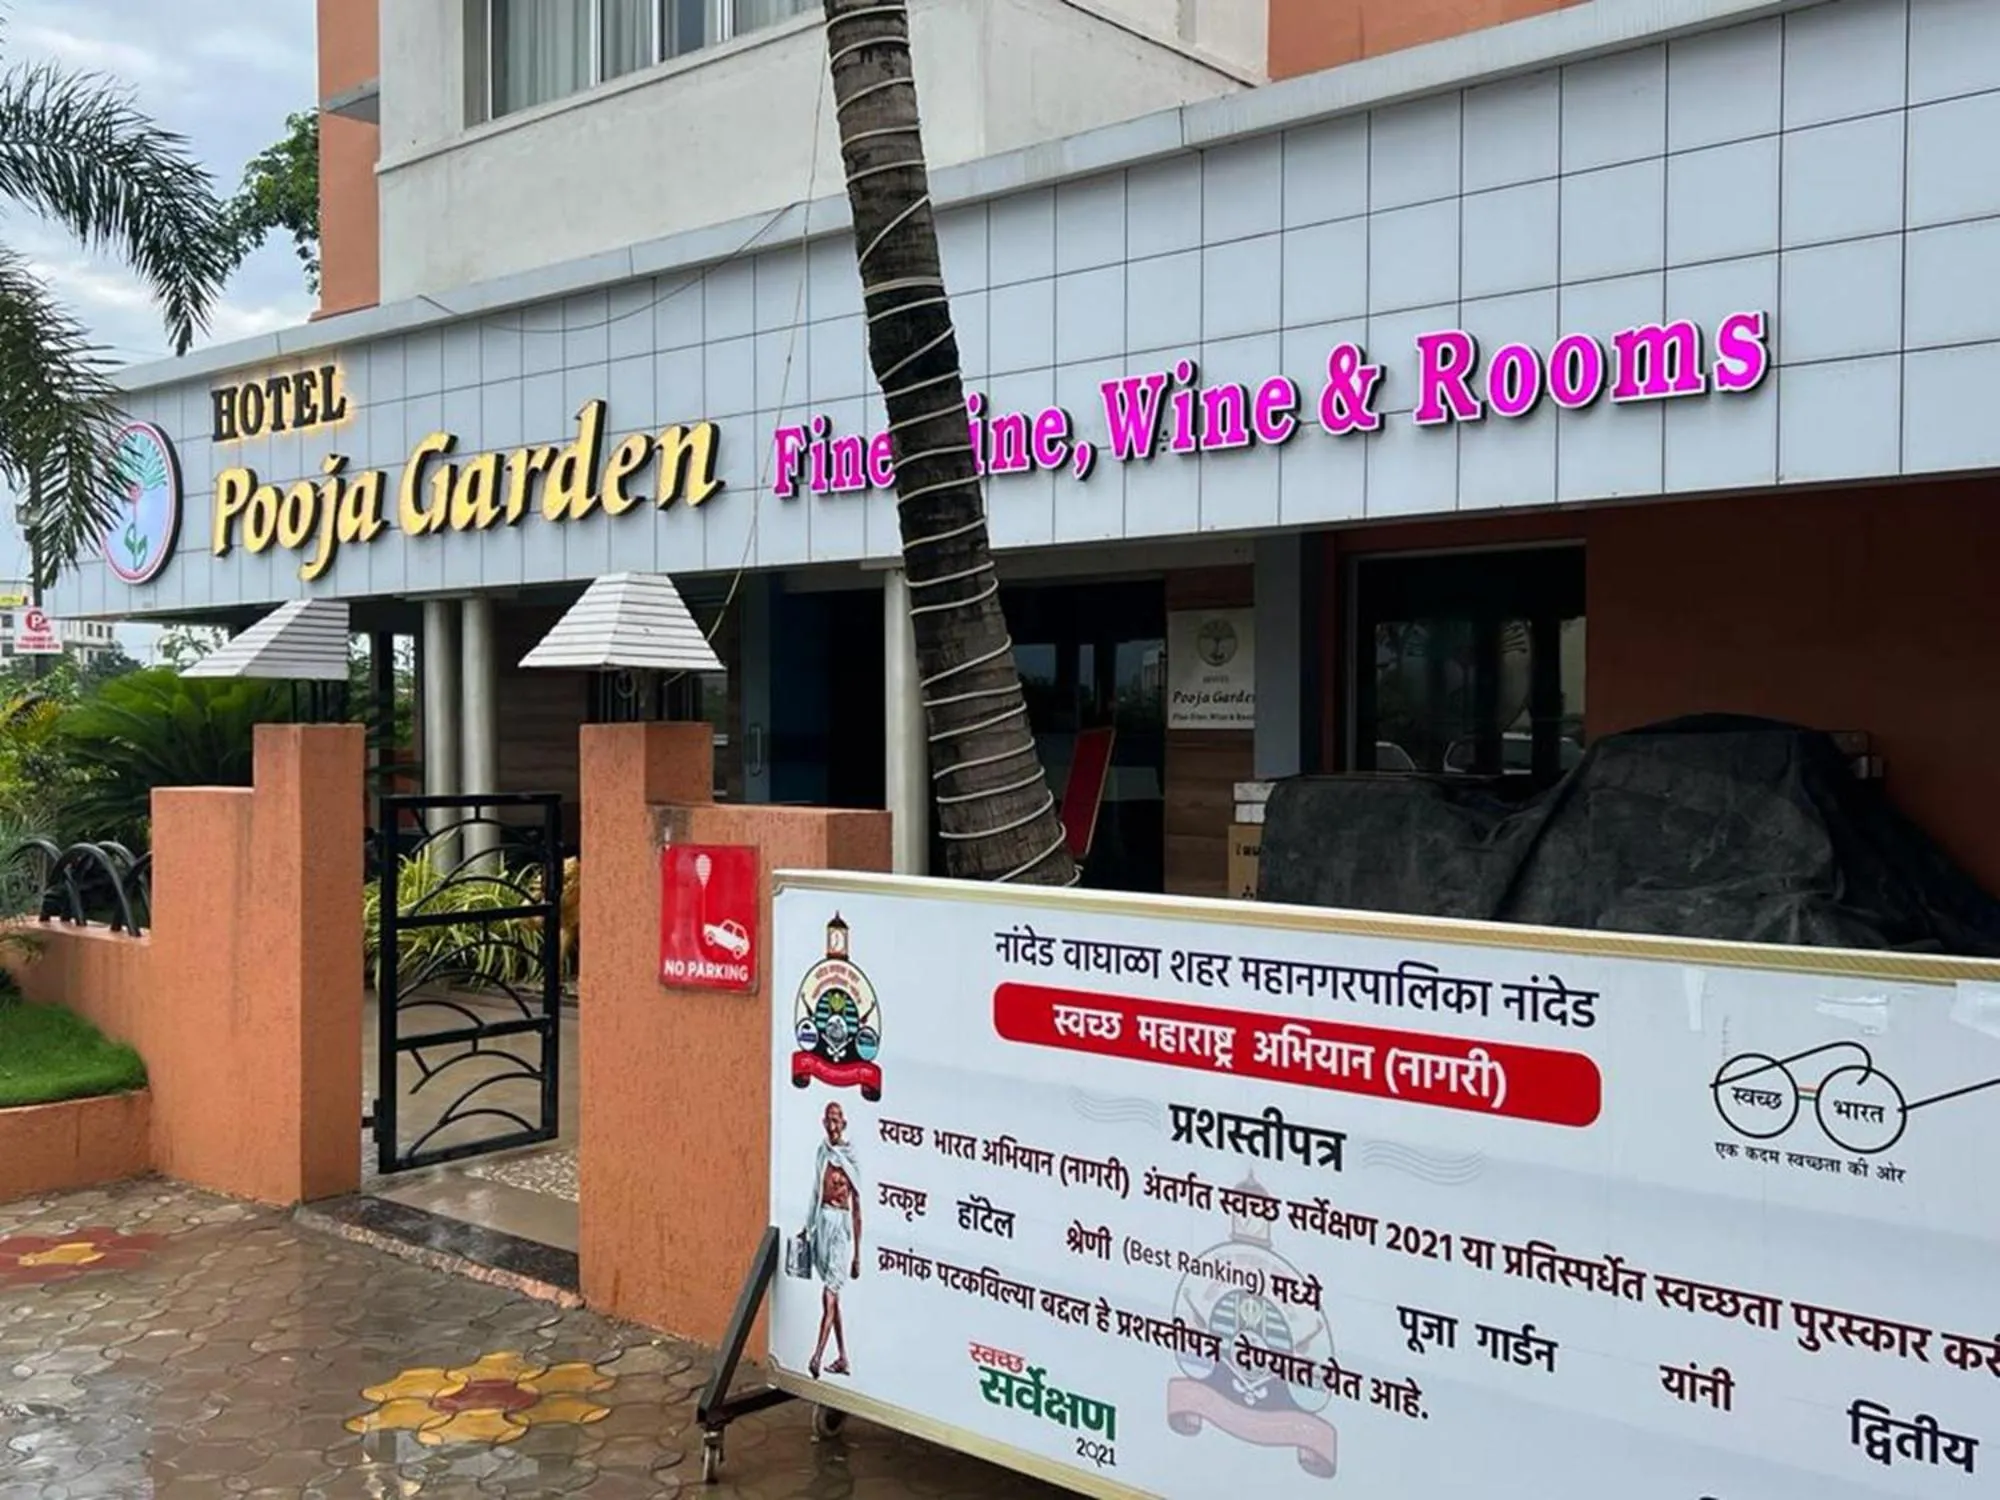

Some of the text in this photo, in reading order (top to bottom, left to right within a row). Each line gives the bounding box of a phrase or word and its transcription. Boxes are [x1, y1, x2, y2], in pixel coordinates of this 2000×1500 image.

[211, 363, 347, 442] HOTEL
[773, 311, 1773, 497] Fine ine, Wine & Rooms
[212, 400, 725, 581] Pooja Garden
[664, 960, 749, 982] NO PARKING
[995, 925, 1600, 1029] नांदेड वाघाळा शहर महानगरपालिका नांदेड
[1053, 1003, 1508, 1109] स्वच्छ महाराष्ट्र अभियान (नागरी)
[1170, 1103, 1347, 1172] प्रशस्तीपत्र
[1731, 1086, 1783, 1110] स्वच्छ
[1834, 1099, 1884, 1123] भारत
[1715, 1141, 1906, 1183] एक कदम स्वच्छता की ओर
[879, 1119, 924, 1147] स्वच्छ
[934, 1130, 977, 1160] भारत
[982, 1135, 1055, 1176] अभियान
[1059, 1155, 1131, 1199] (नागरी)
[1143, 1167, 1214, 1211] अंतर्गत
[1218, 1186, 1281, 1222] स्वच्छ
[1287, 1197, 1378, 1246] सर्वेक्षण
[1386, 1223, 1453, 1262] 2021
[1461, 1235, 1494, 1270] या
[1503, 1240, 1647, 1303] प्रतिस्पर्धेत
[1654, 1275, 1782, 1331] स्वच्छता
[1790, 1301, 1932, 1363] पुरस्कार
[878, 1182, 1979, 1474] उत्कृष्ट हॉटेल श्रेणी (Best Ranking) मध्ये पूजा गार्डन यांनी द्वितीय
[878, 1246, 932, 1280] क्रमांक
[1040, 1288, 1090, 1325] बद्दल
[1095, 1297, 1111, 1332] हे
[1116, 1311, 1222, 1362] प्रशस्तीपत्र
[1235, 1334, 1315, 1388] देण्यात
[1322, 1357, 1363, 1401] येत
[1370, 1377, 1429, 1420] आहे.
[969, 1342, 1025, 1374] स्वच्छ
[979, 1365, 1116, 1441] सर्वेक्षण
